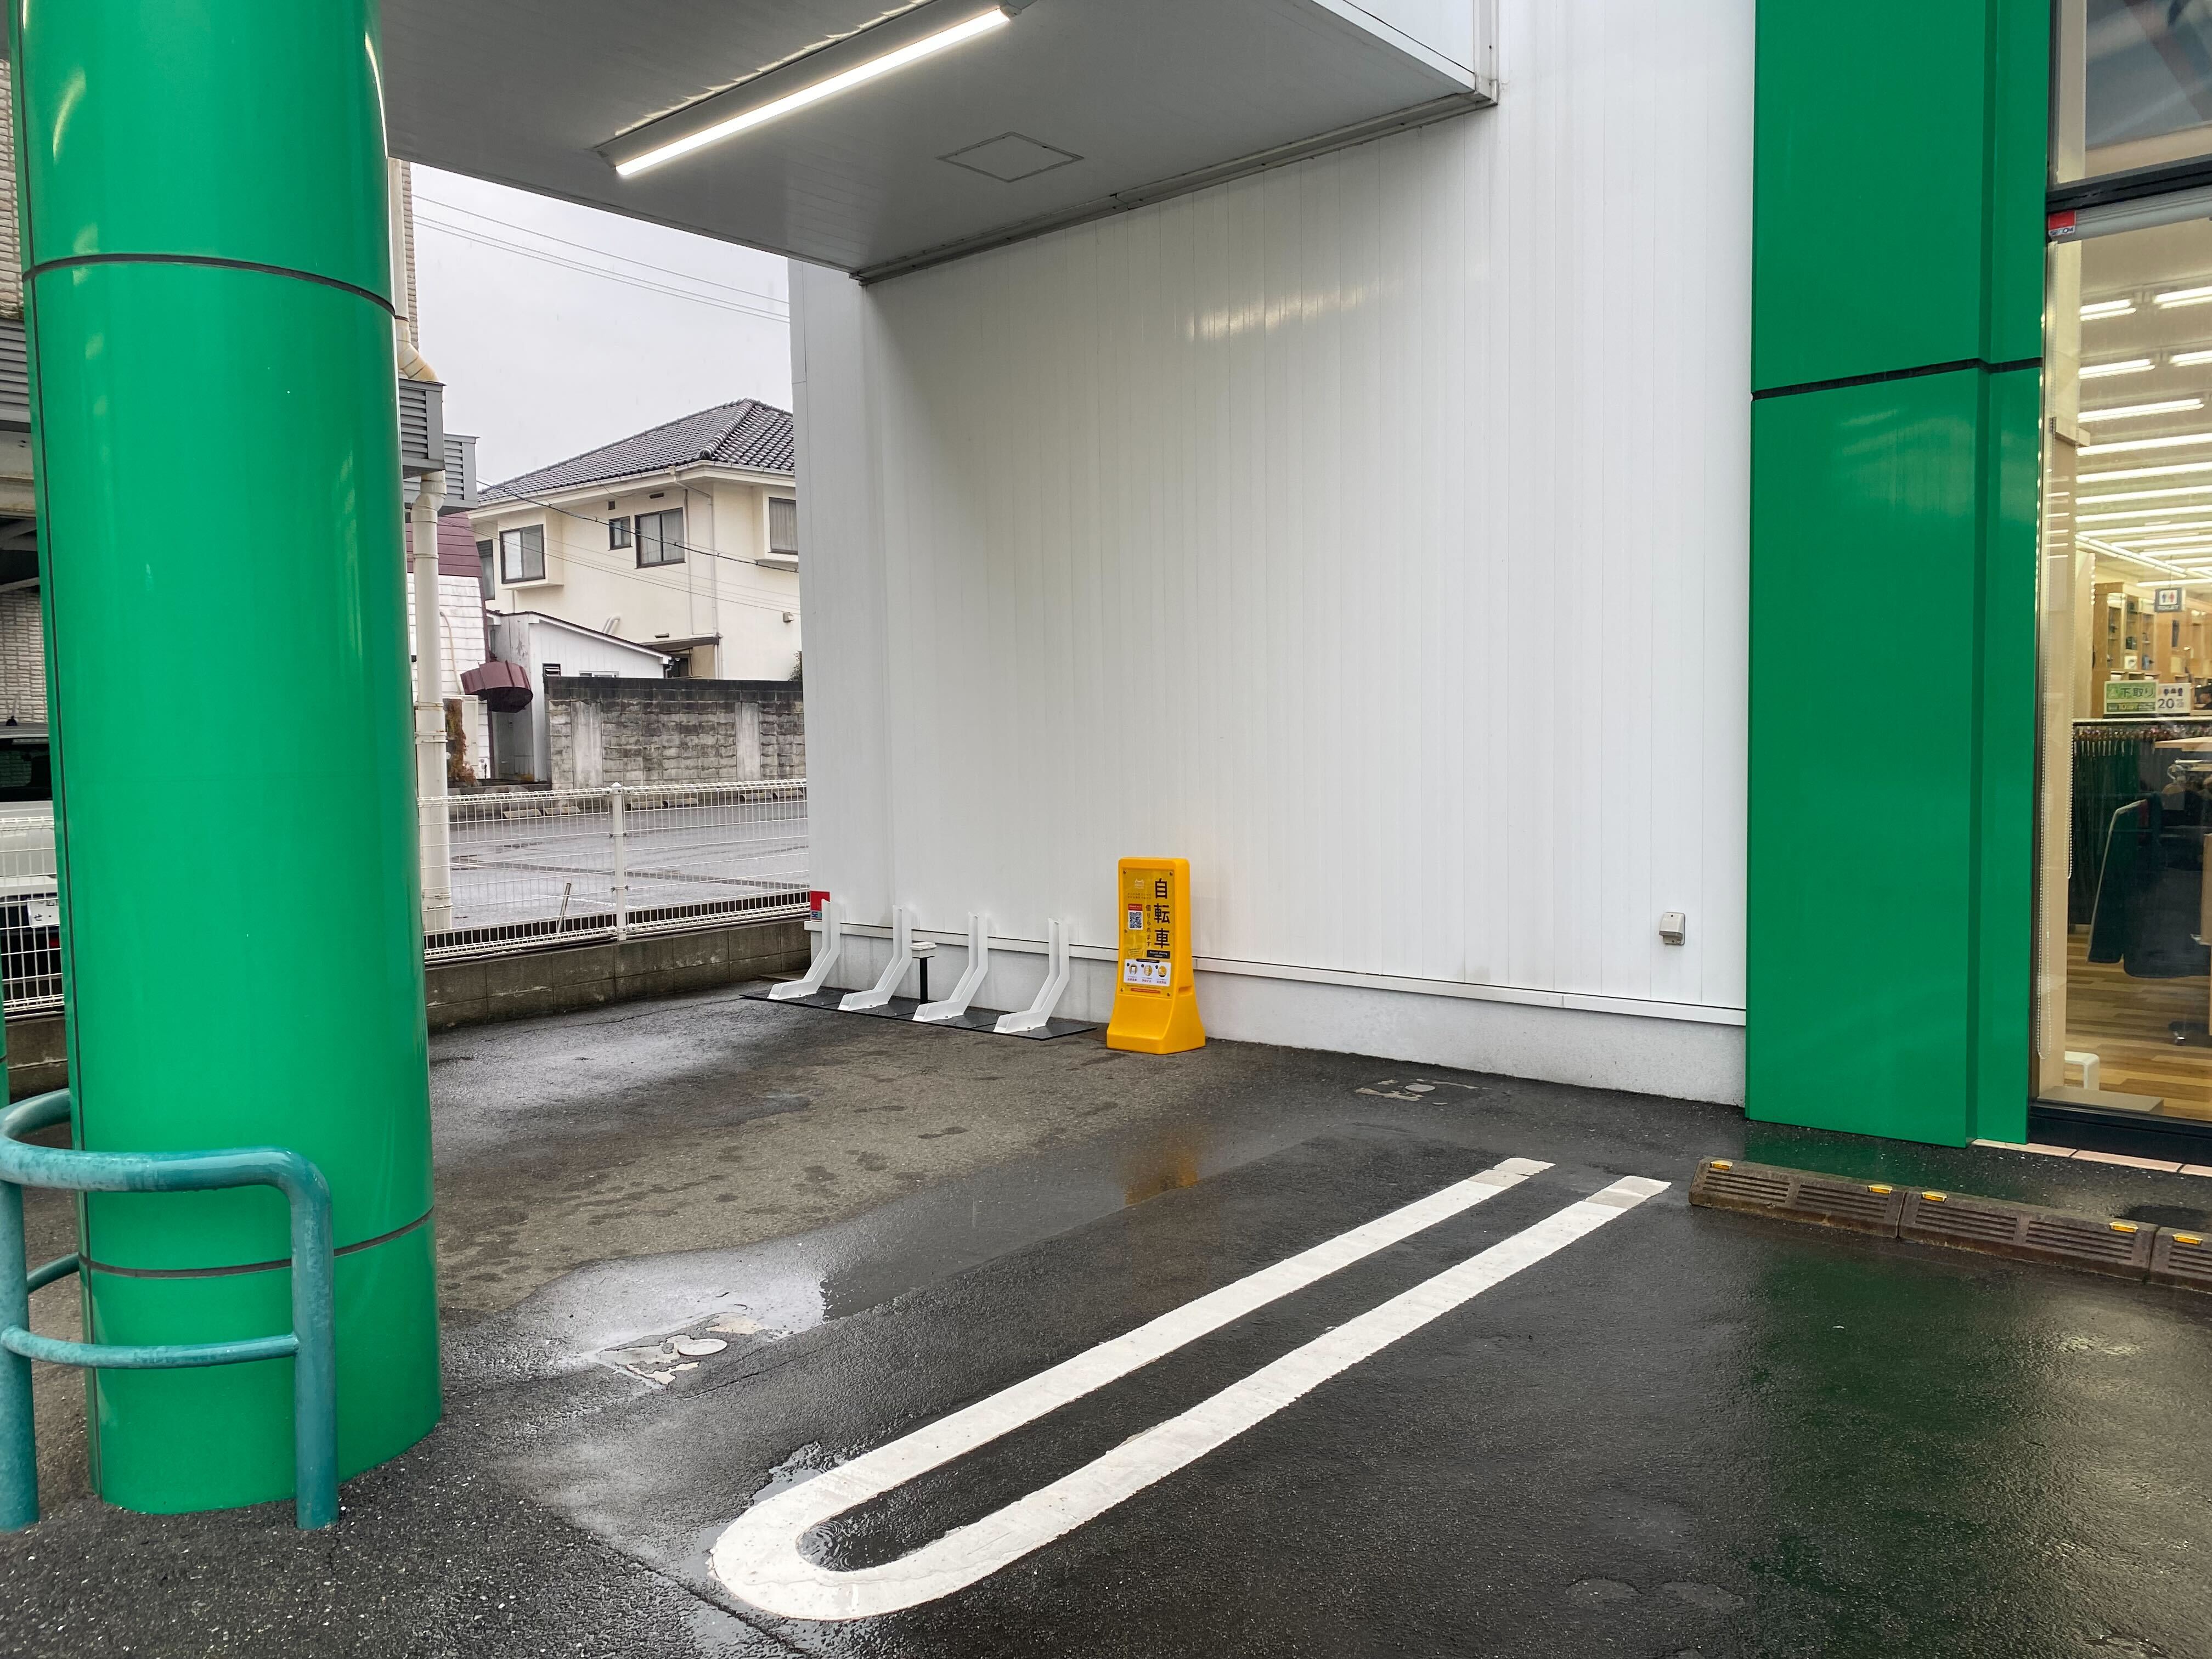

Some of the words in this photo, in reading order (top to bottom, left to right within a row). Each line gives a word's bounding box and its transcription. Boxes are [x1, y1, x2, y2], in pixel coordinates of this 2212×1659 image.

[2120, 687, 2153, 697] 下取り
[2158, 698, 2175, 709] 20
[1154, 878, 1171, 949] 自転車
